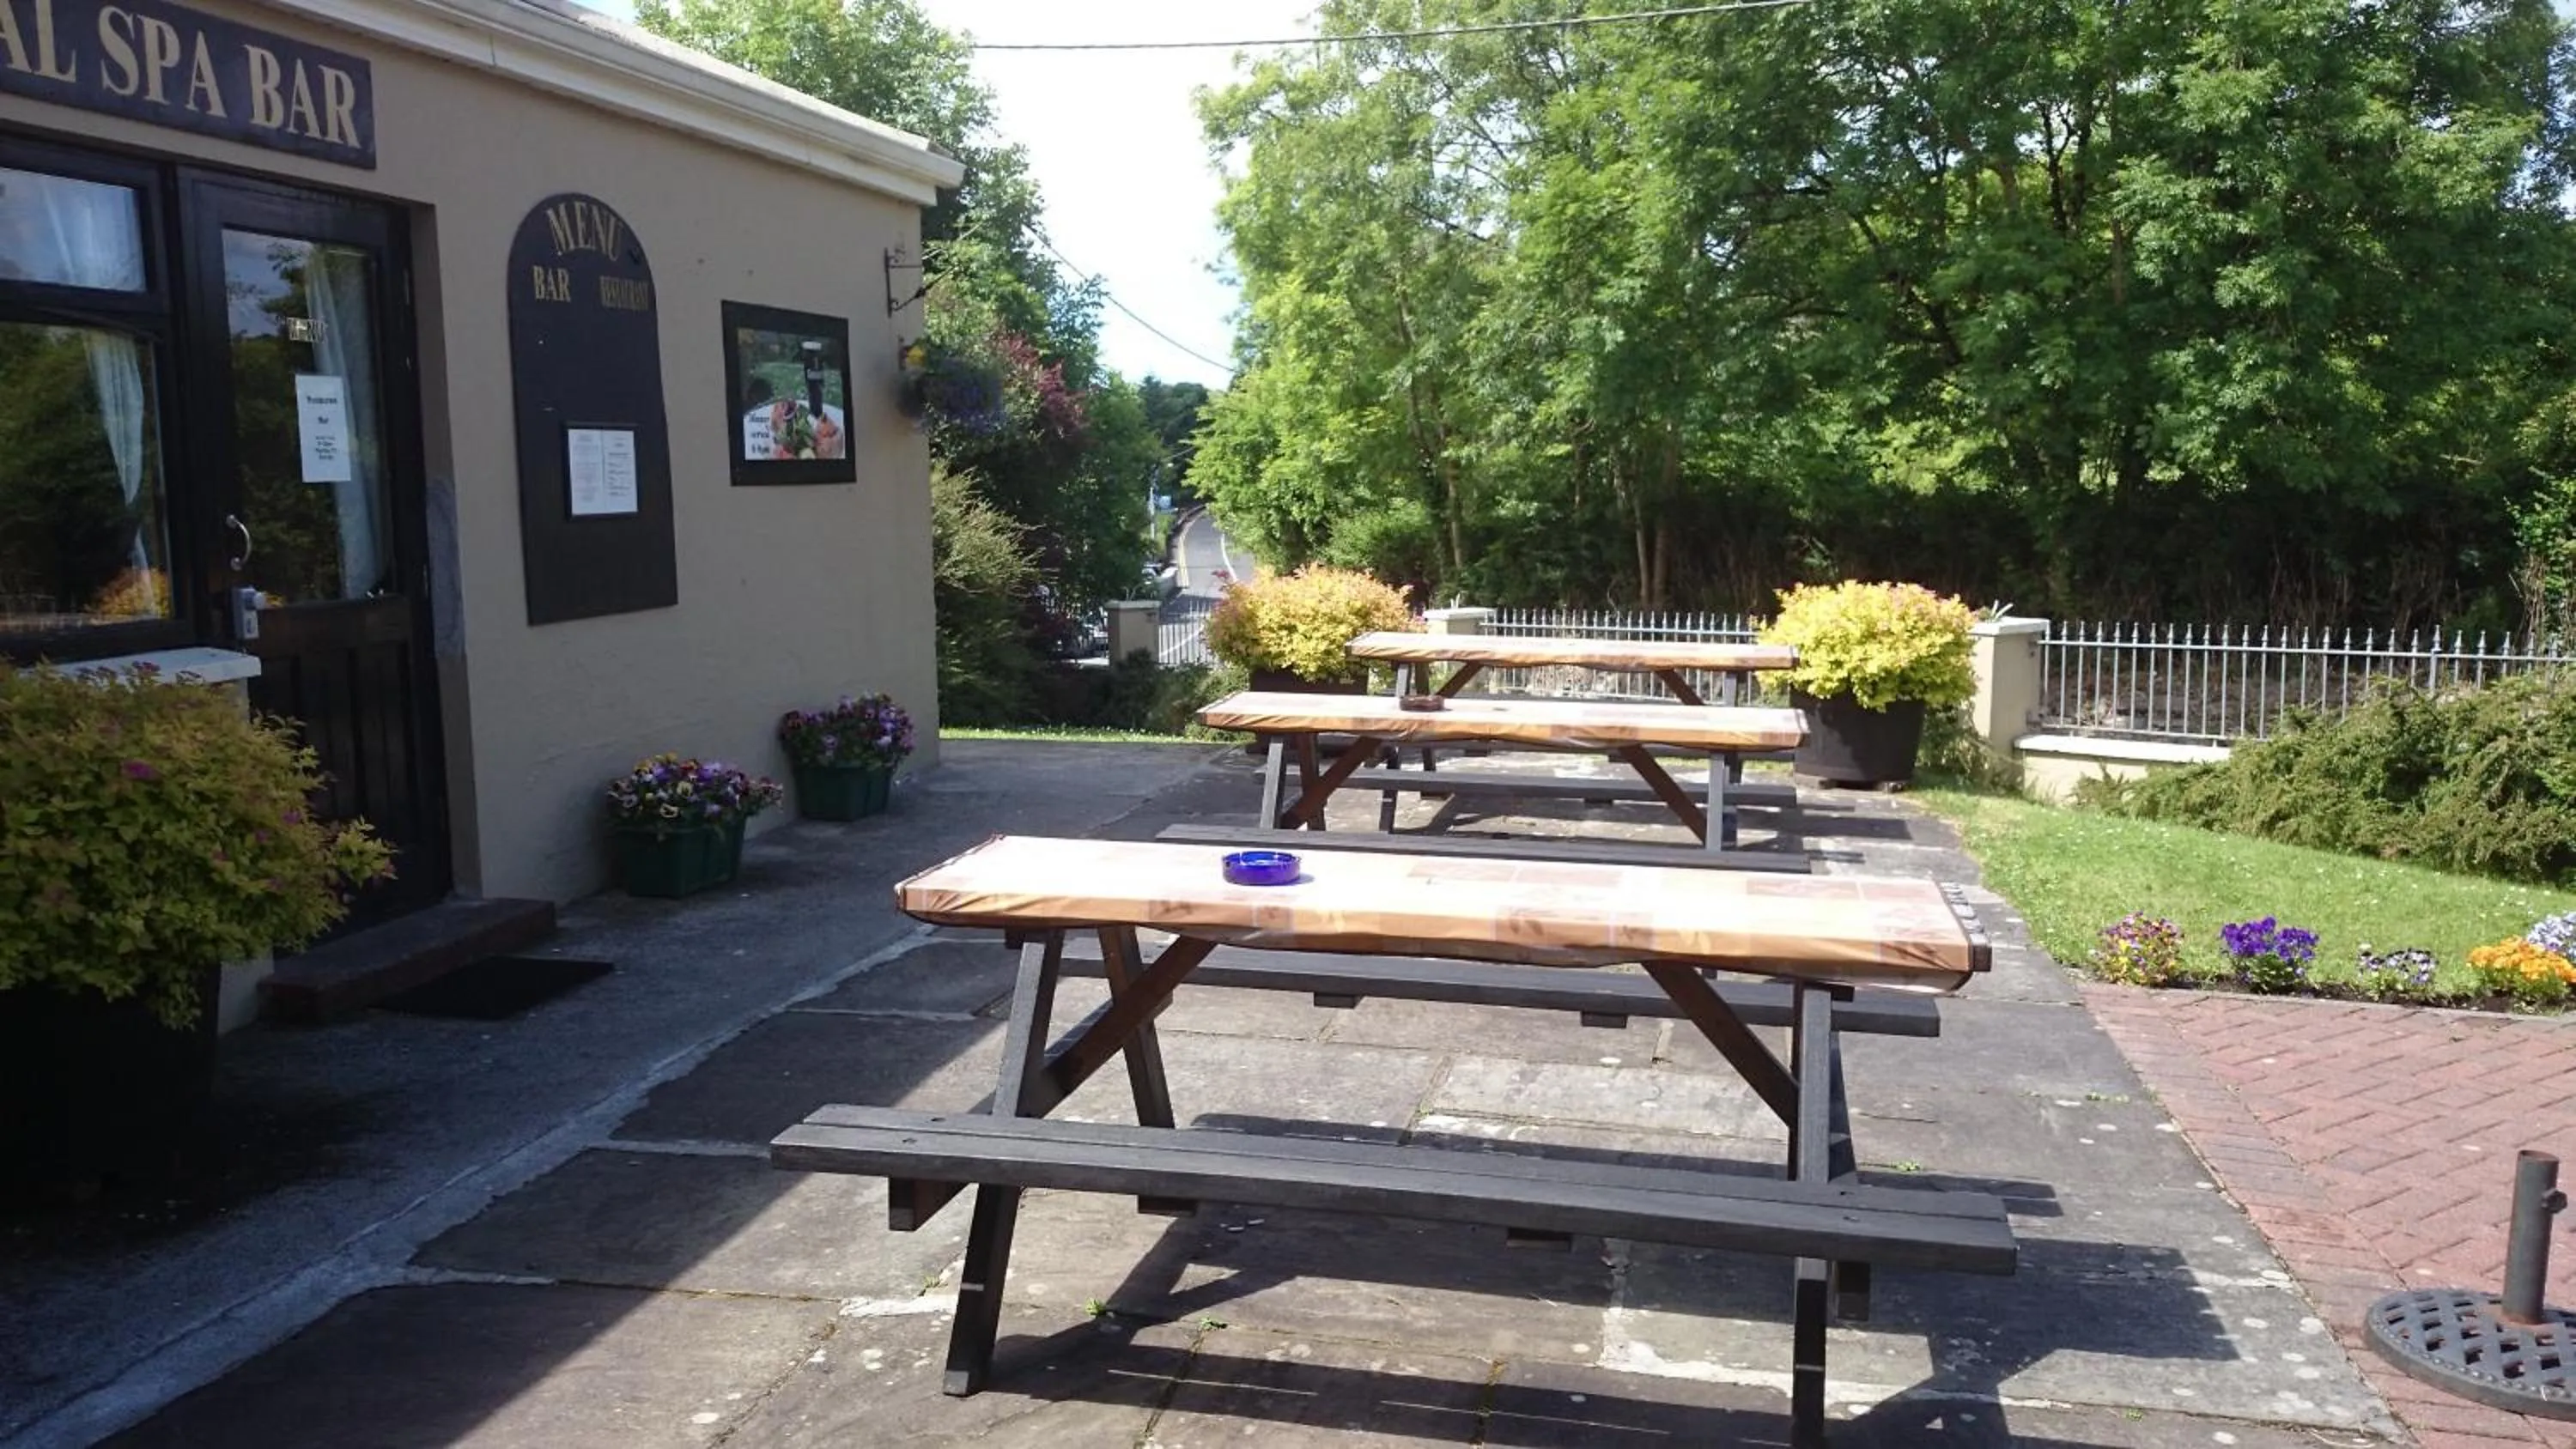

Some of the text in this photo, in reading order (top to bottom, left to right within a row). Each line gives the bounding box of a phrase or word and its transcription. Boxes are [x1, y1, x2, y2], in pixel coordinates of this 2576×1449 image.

[98, 5, 228, 118] SPA
[244, 44, 361, 149] BAR
[547, 201, 624, 262] MENU
[532, 265, 571, 302] BAR
